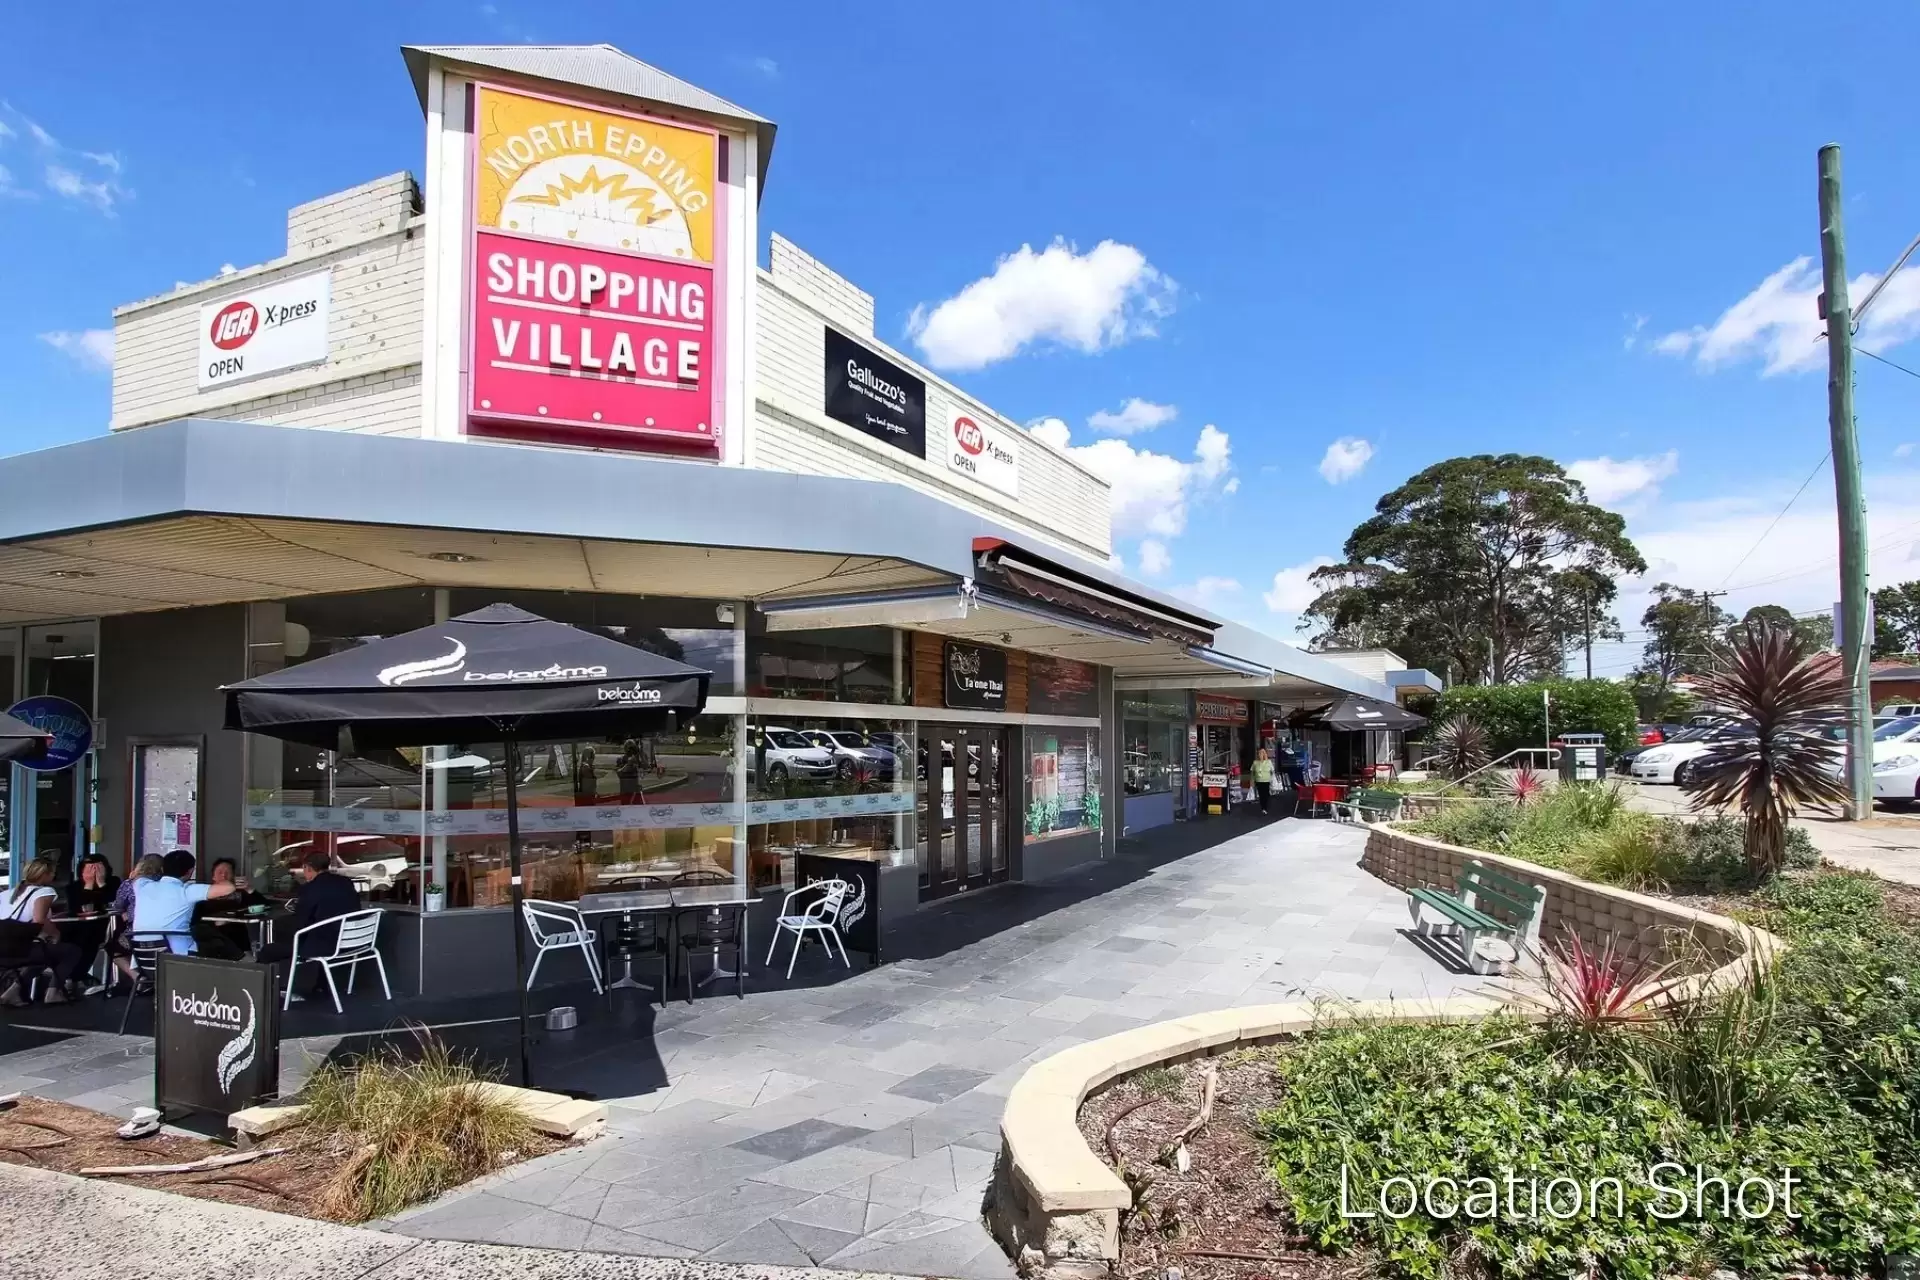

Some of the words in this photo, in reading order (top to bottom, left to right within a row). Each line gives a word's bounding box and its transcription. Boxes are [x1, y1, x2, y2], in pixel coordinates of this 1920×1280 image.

[485, 120, 594, 180] NORTH
[604, 125, 709, 214] EPPING
[487, 252, 705, 321] SHOPPING
[214, 306, 255, 343] IGA
[264, 299, 317, 327] X-press
[208, 355, 243, 379] OPEN
[491, 317, 701, 380] VILLAGE
[847, 358, 907, 405] Galluzzo's
[957, 421, 981, 450] IGA
[954, 453, 976, 474] OPEN
[989, 679, 1004, 691] Thai
